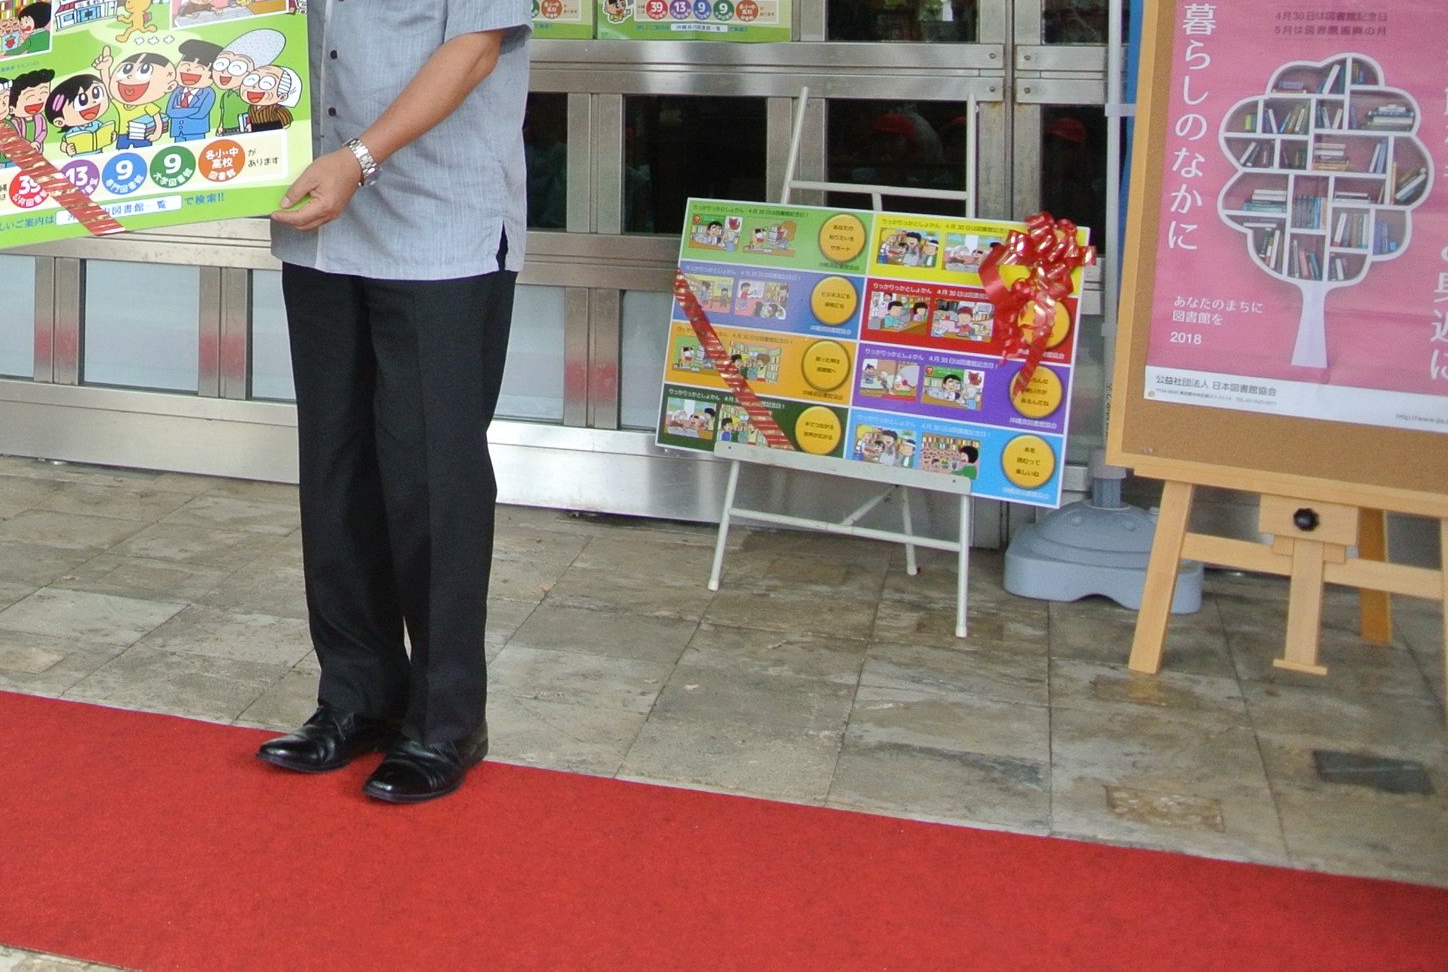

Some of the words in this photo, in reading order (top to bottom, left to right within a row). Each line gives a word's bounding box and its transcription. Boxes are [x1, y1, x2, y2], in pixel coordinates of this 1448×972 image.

[651, 1, 663, 11] 39
[674, 2, 686, 12] 13
[698, 2, 706, 12] 9
[719, 4, 728, 14] 9
[1168, 3, 1216, 251] 暮らしのなかに
[115, 159, 134, 180] 9
[163, 153, 182, 174] 9
[66, 166, 89, 186] 13
[1174, 296, 1263, 313] あなたのまちに
[1172, 310, 1223, 325] 図書館を
[1170, 331, 1202, 345] 2018
